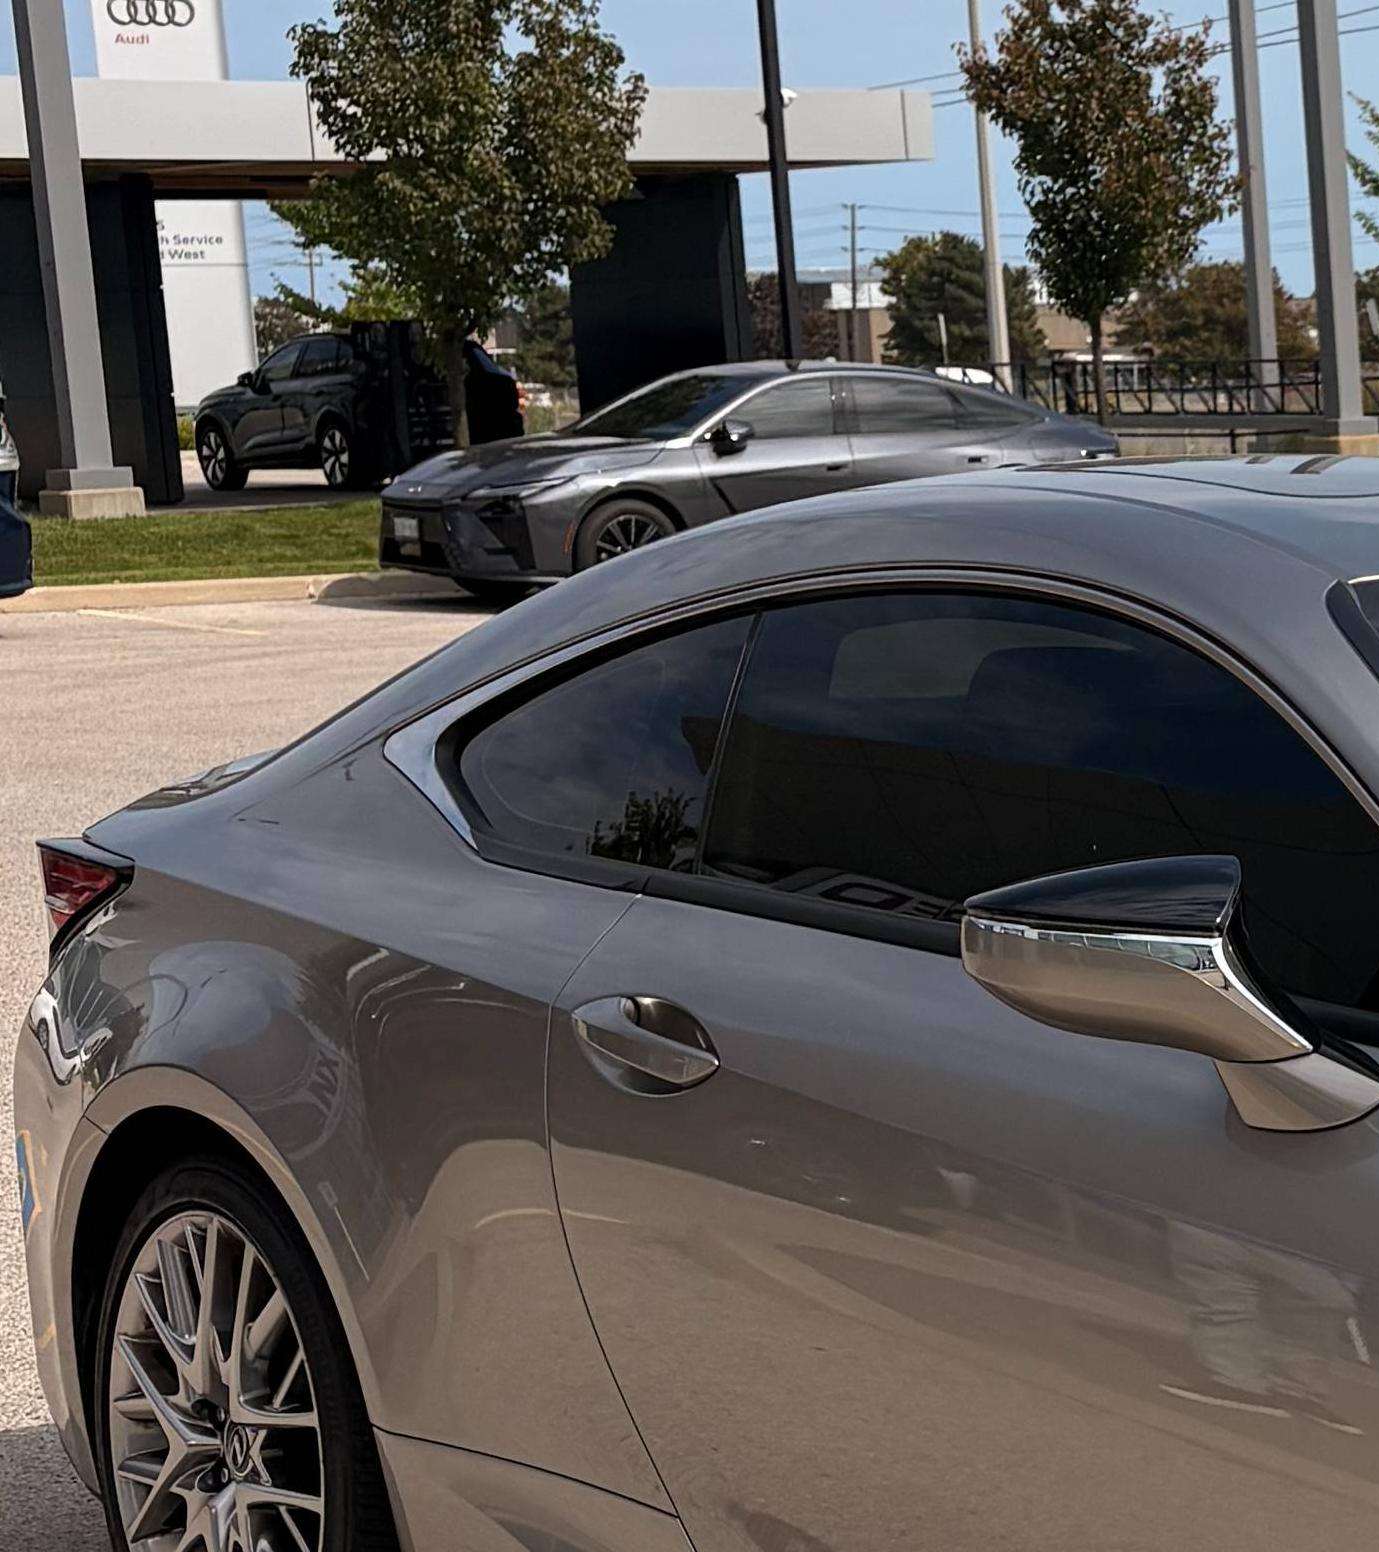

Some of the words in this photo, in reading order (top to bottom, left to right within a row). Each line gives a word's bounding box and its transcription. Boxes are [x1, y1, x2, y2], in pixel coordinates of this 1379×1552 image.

[115, 33, 149, 45] Audi
[173, 234, 223, 245] Service
[168, 249, 205, 260] West
